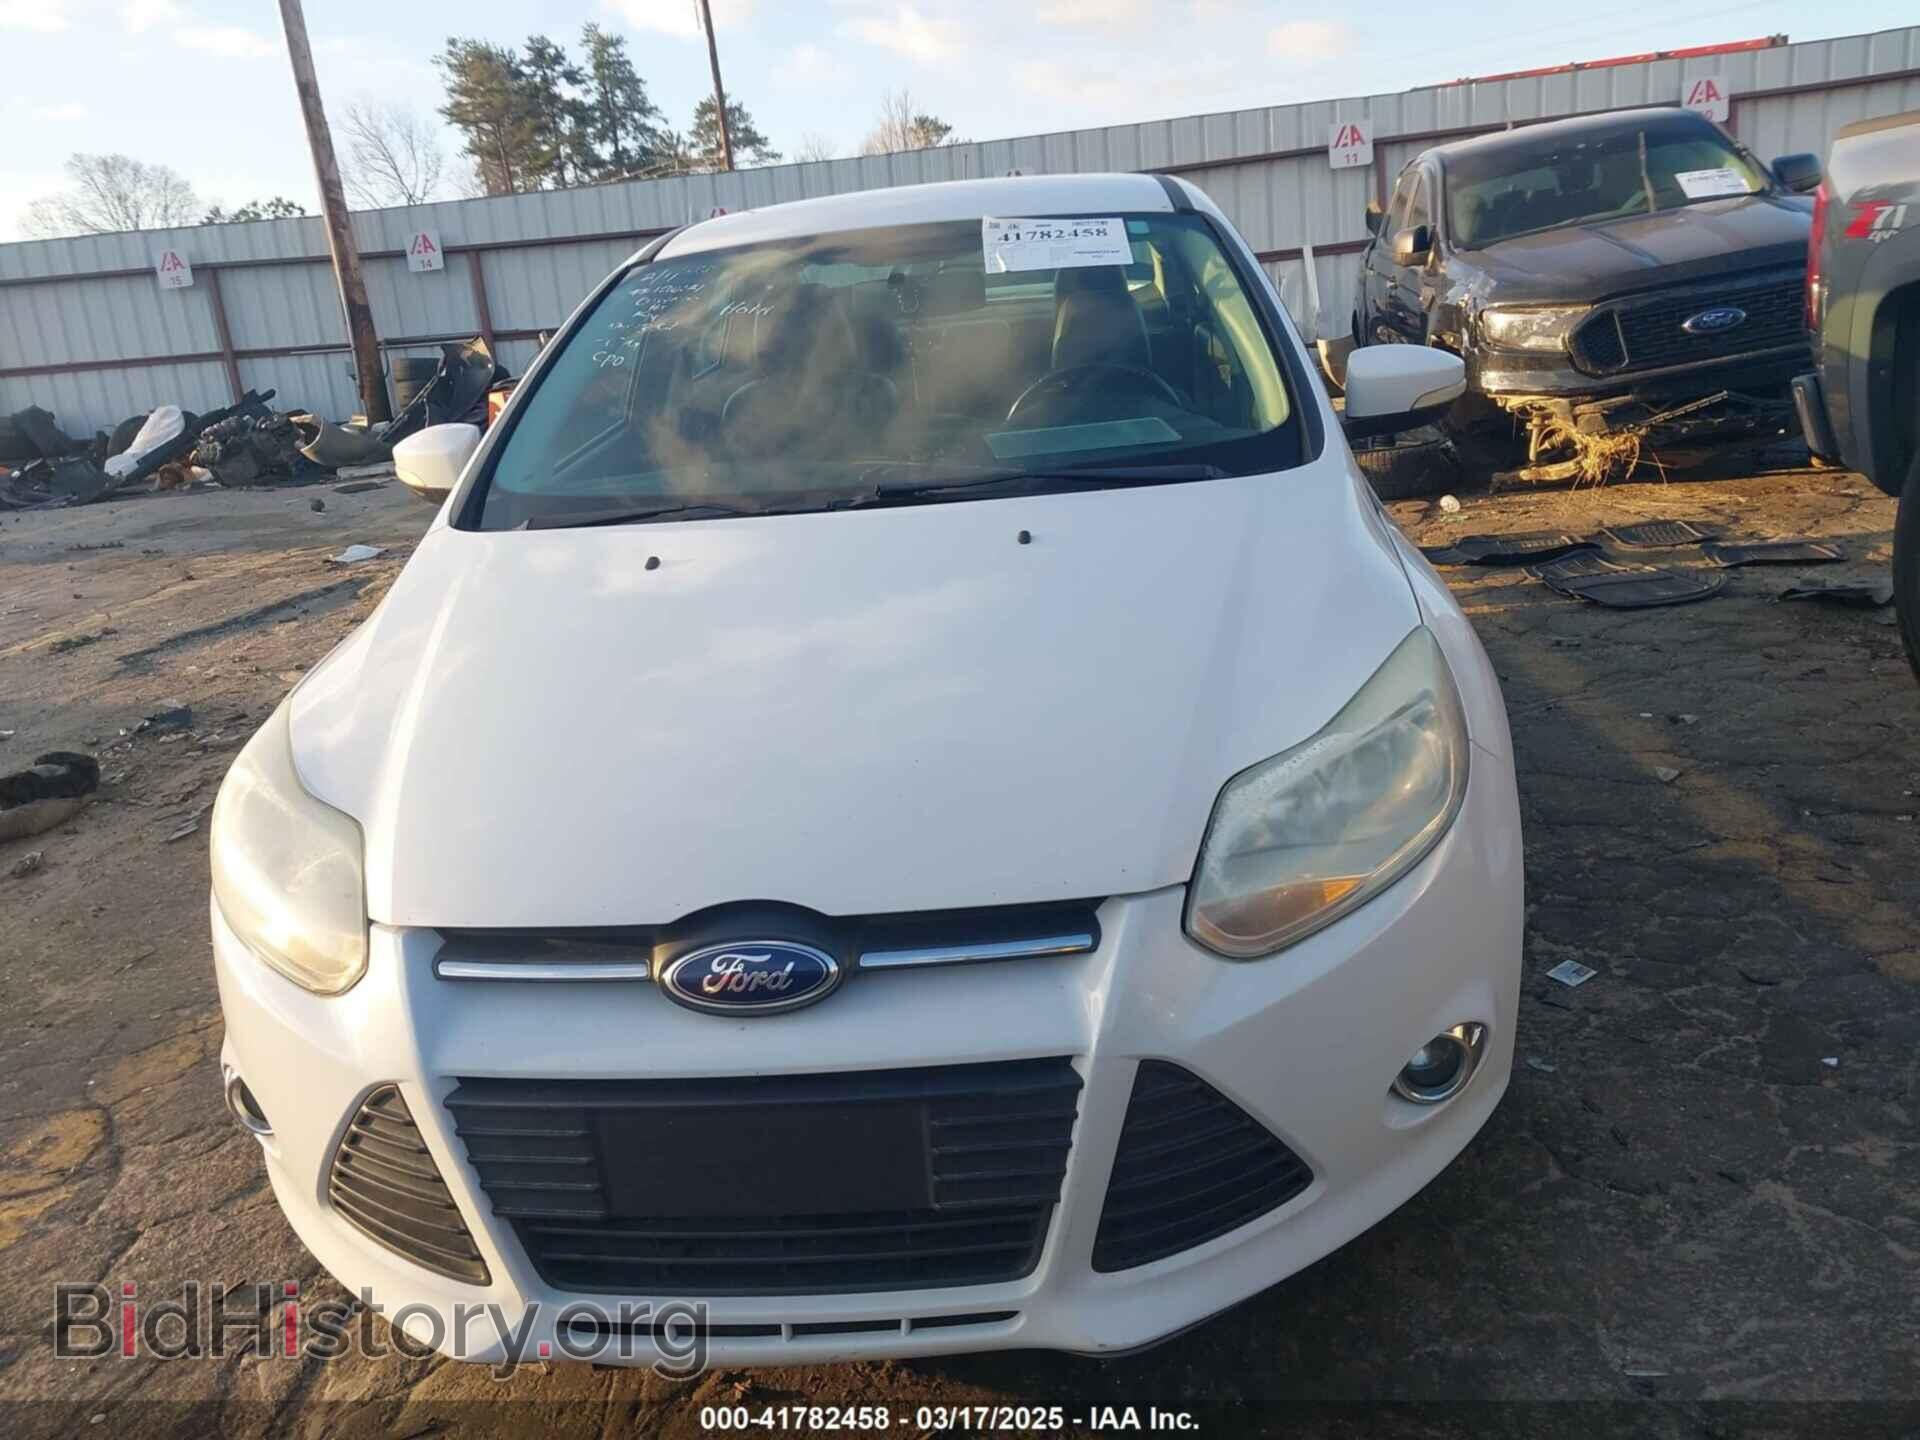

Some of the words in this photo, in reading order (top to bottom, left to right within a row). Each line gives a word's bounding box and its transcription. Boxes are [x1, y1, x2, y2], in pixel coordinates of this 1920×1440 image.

[1344, 152, 1359, 164] 11
[1844, 199, 1908, 240] Z71
[998, 227, 1108, 242] 41782458
[702, 953, 795, 993] Ford
